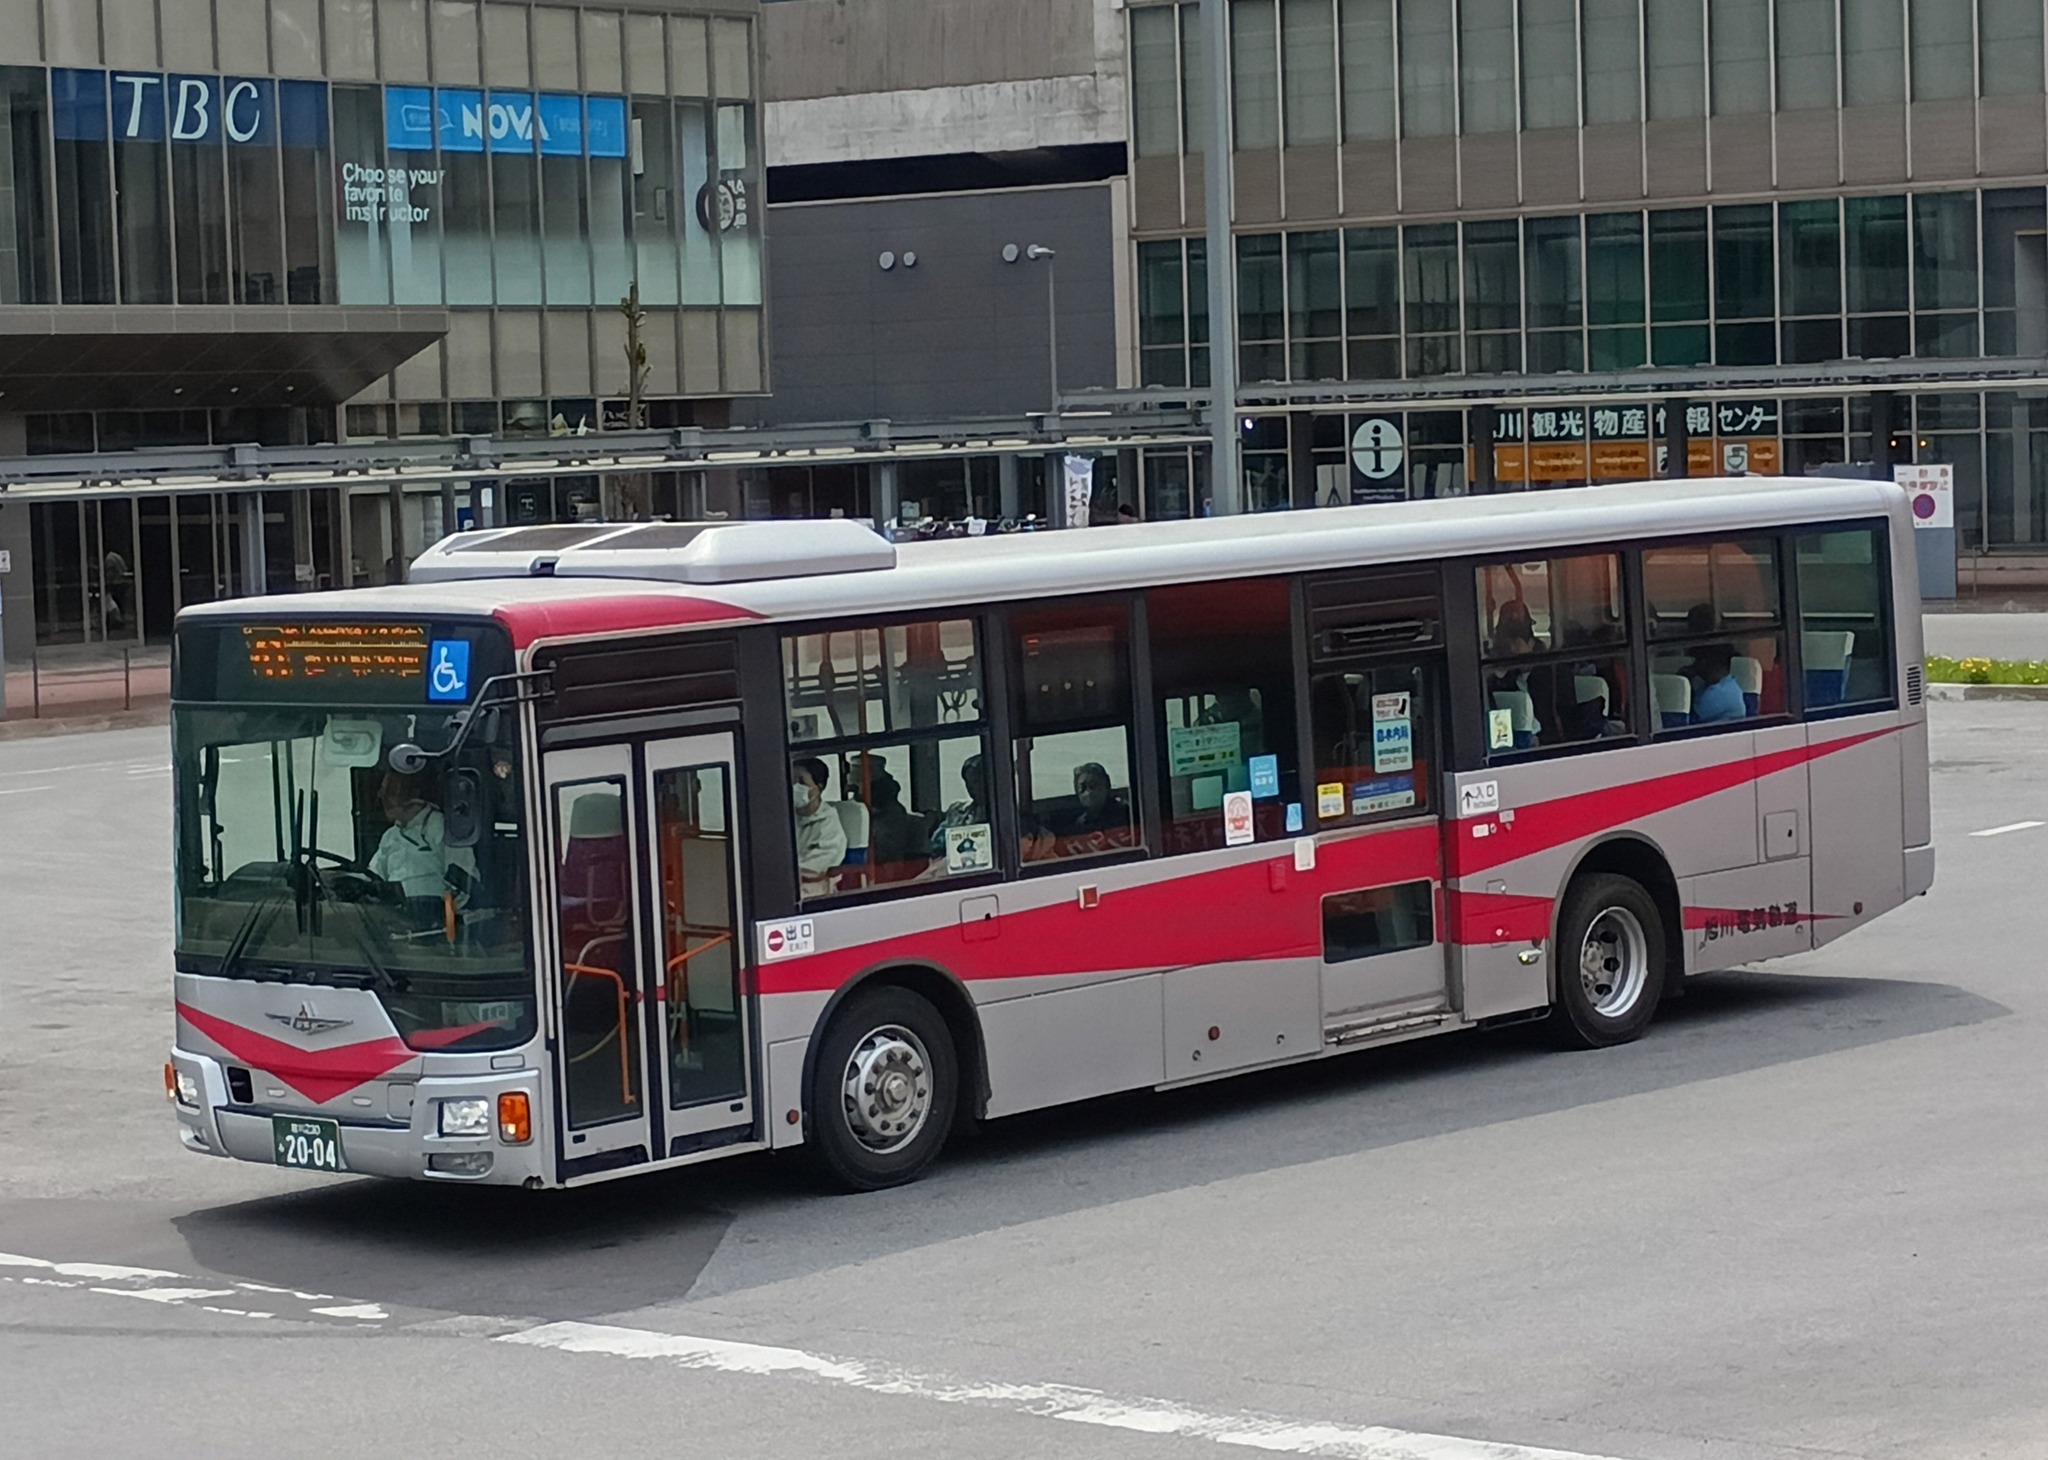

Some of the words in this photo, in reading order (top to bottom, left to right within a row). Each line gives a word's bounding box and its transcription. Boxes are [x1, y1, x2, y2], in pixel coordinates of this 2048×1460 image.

[115, 76, 260, 143] TBC
[462, 103, 551, 141] NOVA
[342, 162, 406, 184] Choose
[409, 169, 446, 191] your
[344, 182, 403, 202] favorite
[346, 203, 430, 223] instructor
[1493, 405, 1778, 439] 川観光物産報センター
[786, 923, 812, 941] 出口
[285, 1134, 336, 1168] 20-04
